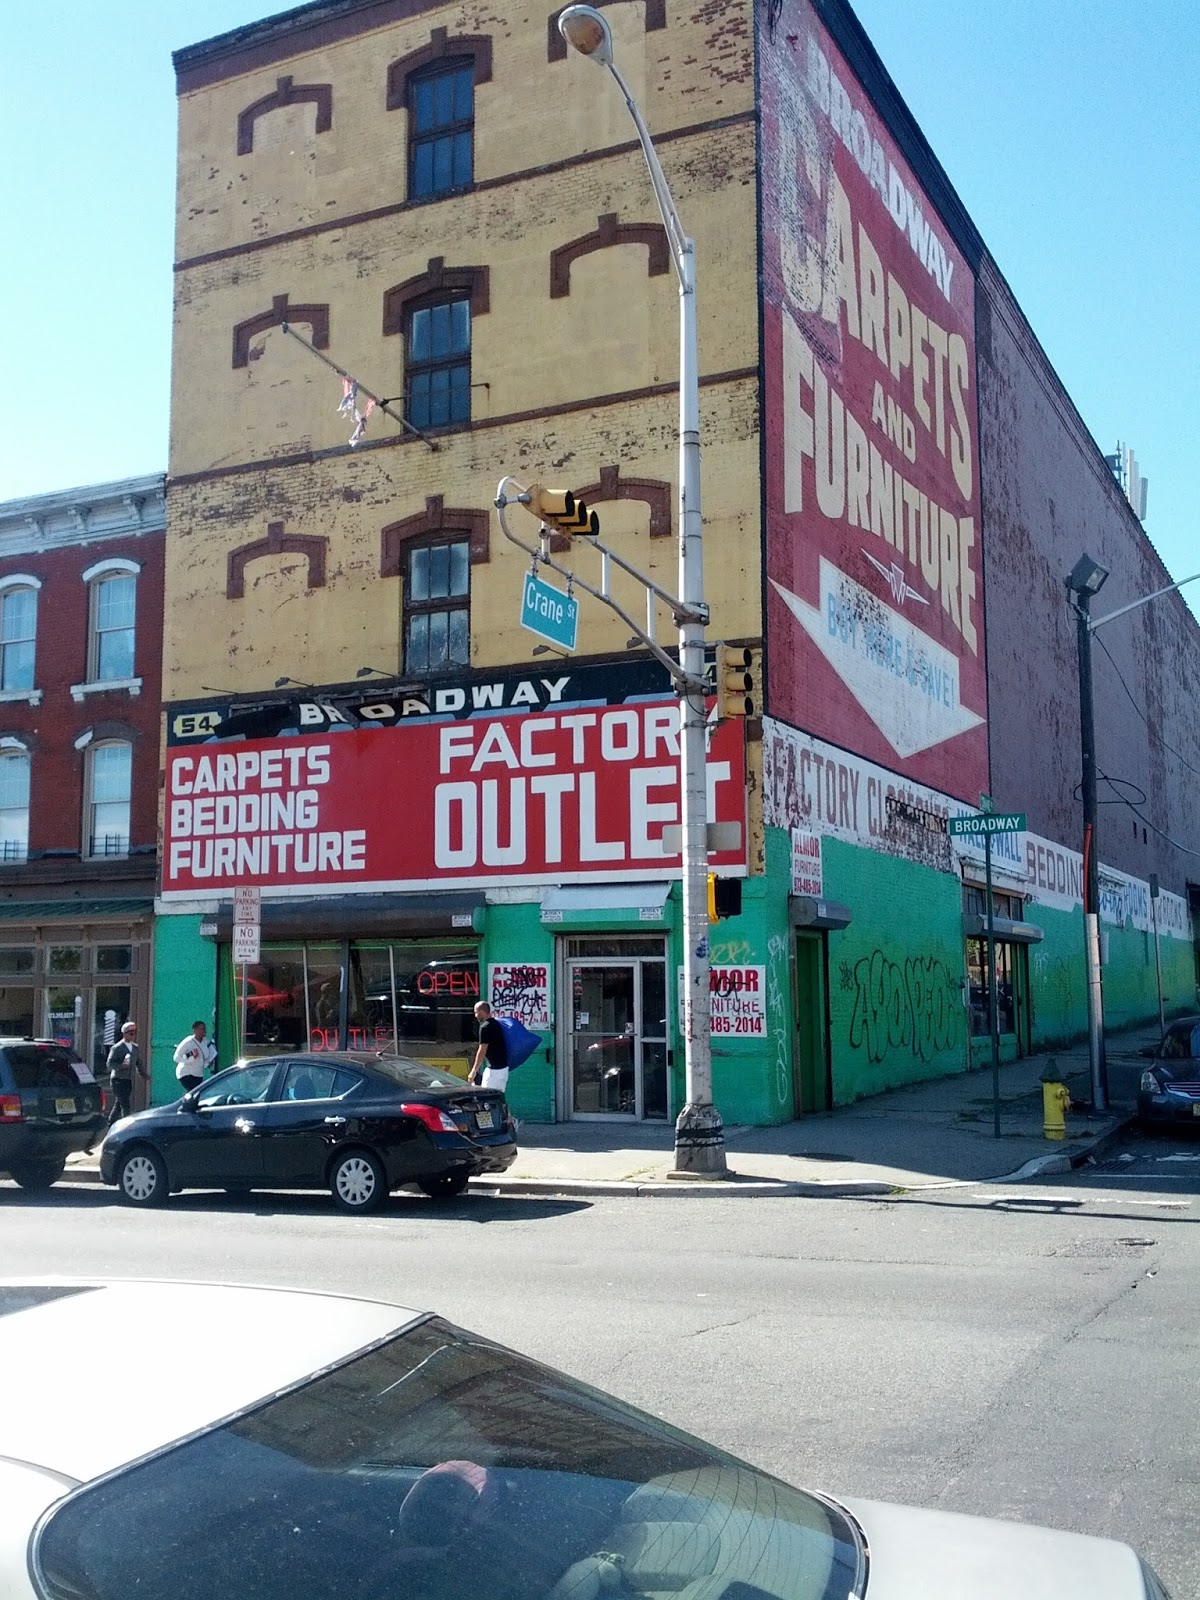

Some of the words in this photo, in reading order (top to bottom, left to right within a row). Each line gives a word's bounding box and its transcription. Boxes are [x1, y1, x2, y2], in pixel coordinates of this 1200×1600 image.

[807, 38, 953, 301] BROADWAY
[779, 85, 972, 501] CARPETS
[872, 379, 916, 464] AND
[782, 302, 978, 658] FURNITURE
[527, 582, 563, 624] Crane
[567, 604, 575, 618] St
[181, 715, 212, 732] 54
[299, 676, 572, 725] BROADWAY
[172, 745, 330, 795] CARPETS
[772, 737, 860, 832] FACTORY
[171, 789, 318, 837] BEDDING
[954, 817, 1020, 833] BROADWAY
[170, 829, 366, 879] FURNITURE
[242, 889, 253, 897] NO
[240, 928, 254, 938] NO
[417, 970, 479, 996] OPEN
[710, 969, 759, 991] MOR
[710, 1016, 762, 1033] 485-2014
[711, 998, 760, 1013] NITURE
